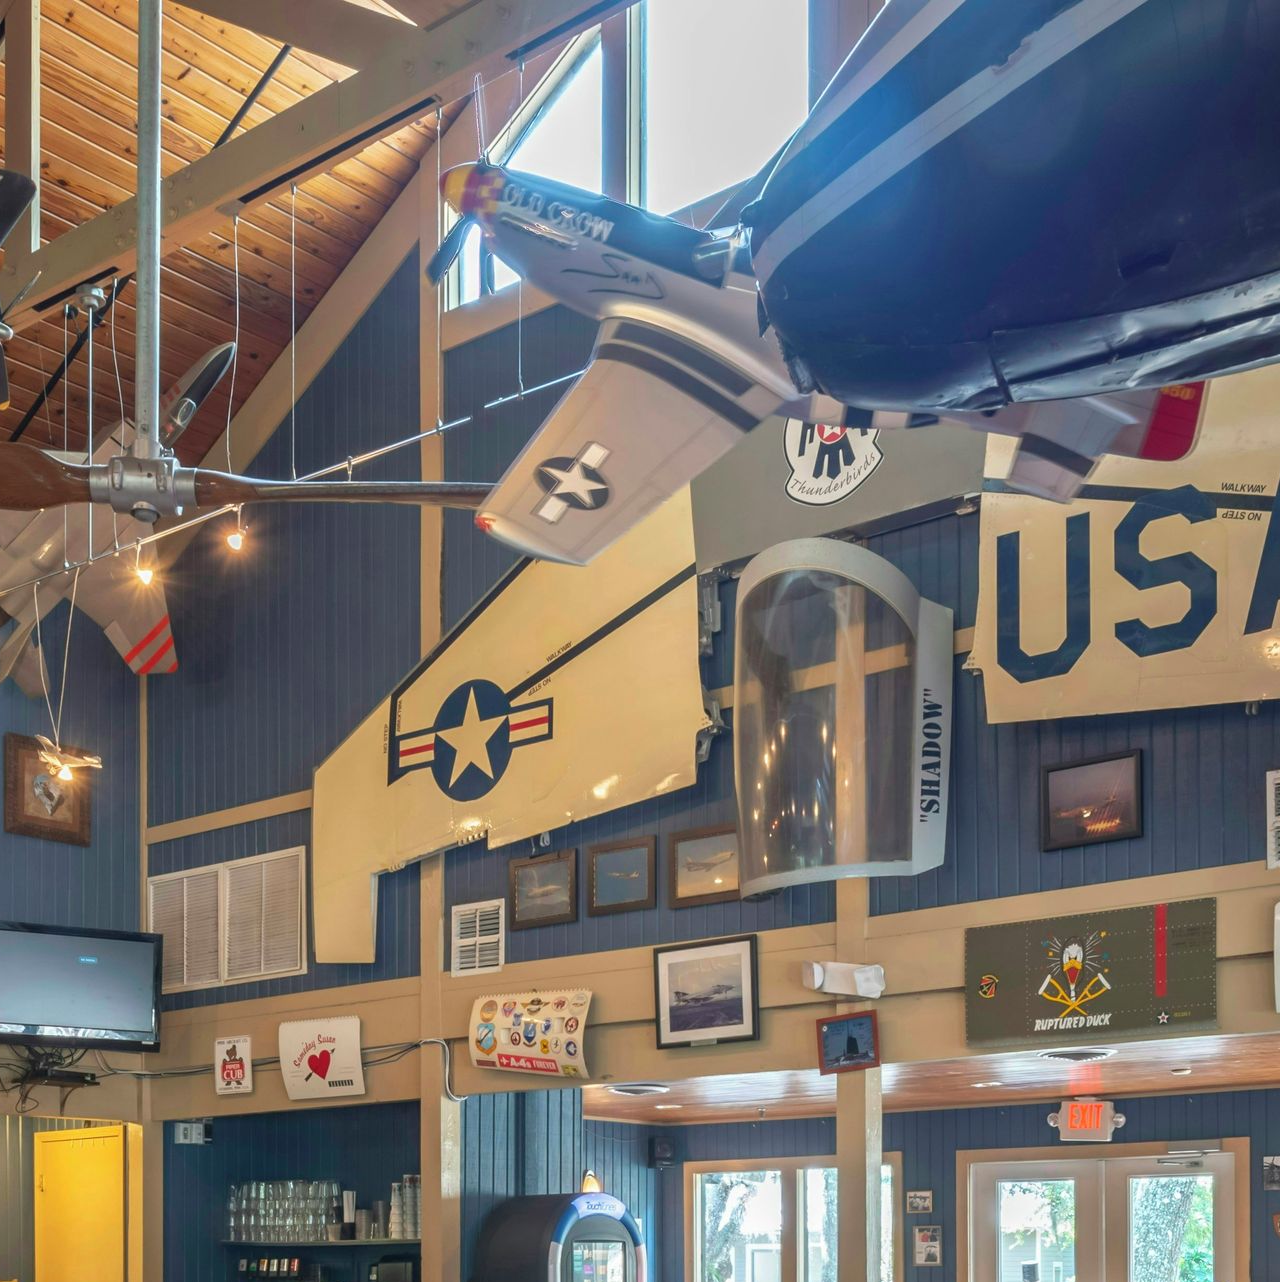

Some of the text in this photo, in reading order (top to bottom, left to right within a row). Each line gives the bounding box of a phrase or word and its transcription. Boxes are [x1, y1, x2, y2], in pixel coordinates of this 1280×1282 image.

[503, 183, 615, 243] OLD CROW
[790, 451, 876, 496] Thunderbirds
[1221, 482, 1267, 494] WALKWAY
[1222, 510, 1262, 521] NO STEP
[546, 640, 573, 663] WALKWAY
[528, 676, 552, 697] NO STEP
[919, 688, 943, 823] "SHADOW"
[1033, 1013, 1113, 1032] RUPTURED DUCK
[223, 1068, 243, 1080] CUB
[1069, 1103, 1103, 1129] EXIT
